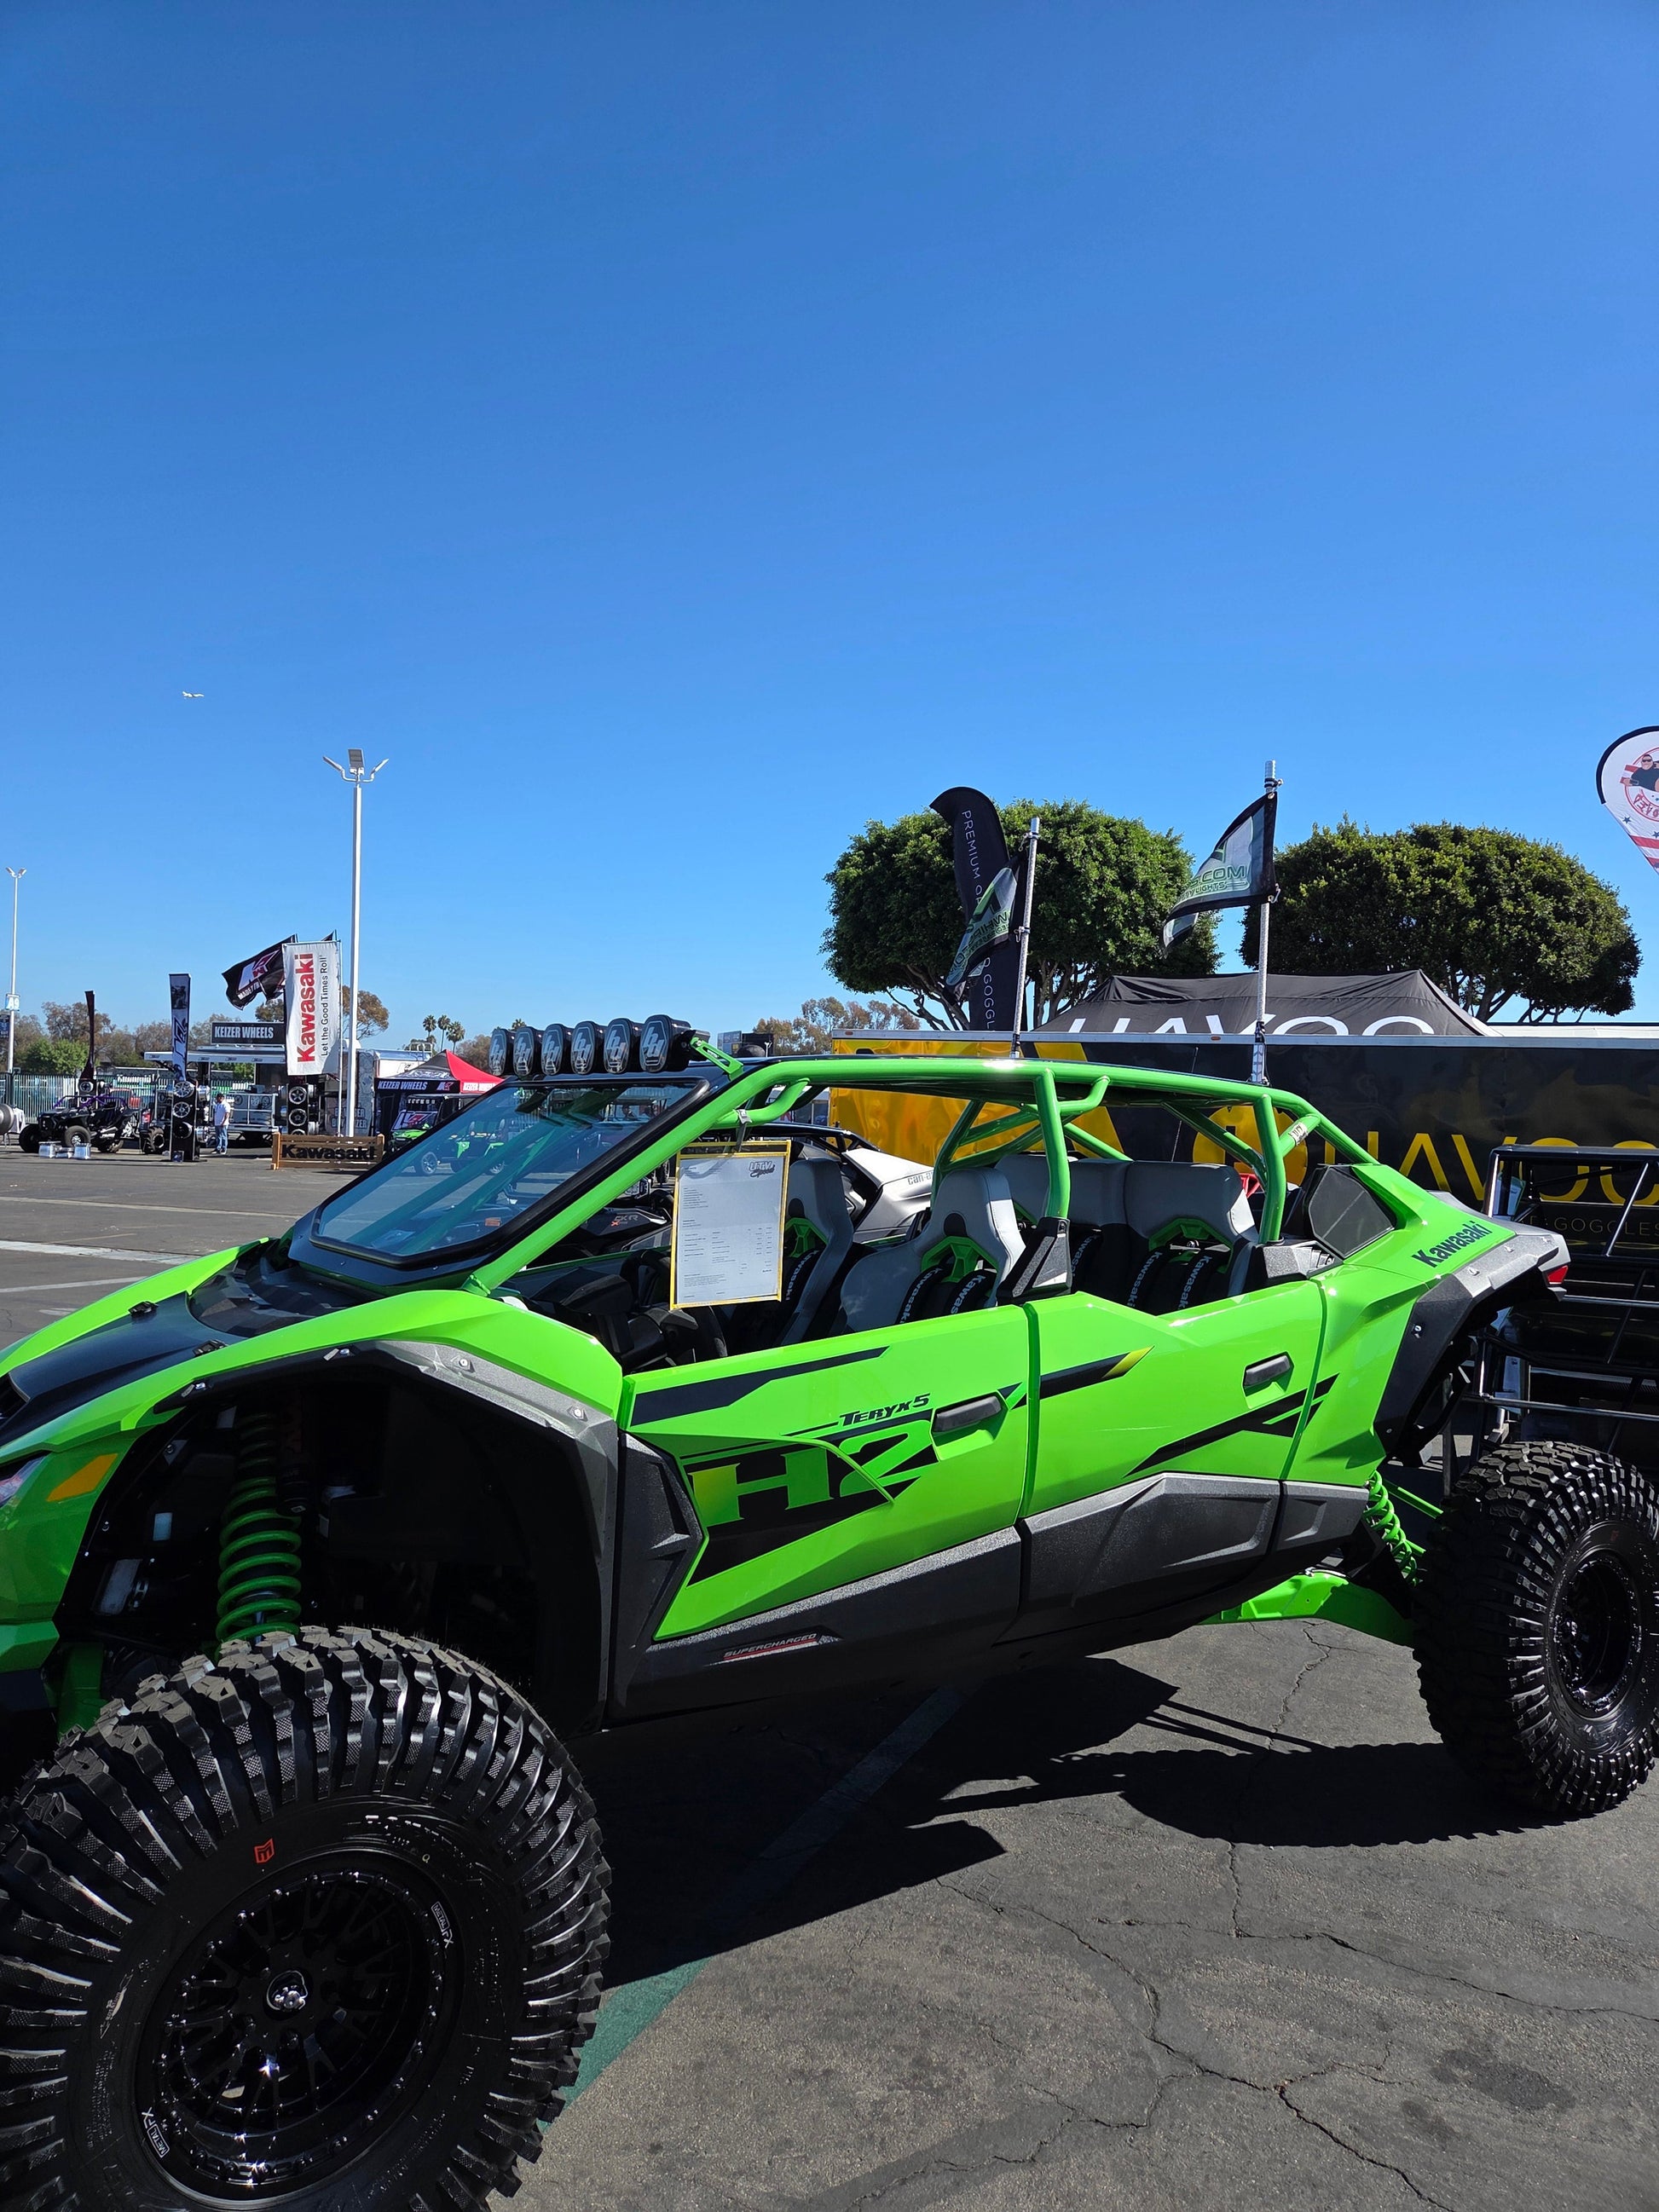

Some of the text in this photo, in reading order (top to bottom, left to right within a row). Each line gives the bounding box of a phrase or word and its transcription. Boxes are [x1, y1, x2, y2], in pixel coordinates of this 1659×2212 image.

[962, 811, 980, 880] PREMIUM
[982, 973, 996, 1031] GOGGL
[320, 975, 328, 1000] Times
[294, 953, 315, 1063] Kawasaki
[321, 1000, 329, 1025] Good
[214, 1026, 274, 1039] KEIZER WHEELS
[378, 1081, 428, 1090] KEIZER WHEELS
[281, 1144, 377, 1161] Kawasaki
[907, 1171, 934, 1185] can-a
[1411, 1220, 1493, 1268] Kawasaki
[1127, 1251, 1163, 1308] Kawasaki
[950, 1274, 986, 1315] Kawas
[687, 1419, 939, 1524] H2
[723, 1632, 818, 1658] SUPERCHARGED
[433, 1903, 447, 1929] METAL
[151, 2128, 167, 2154] METAL
